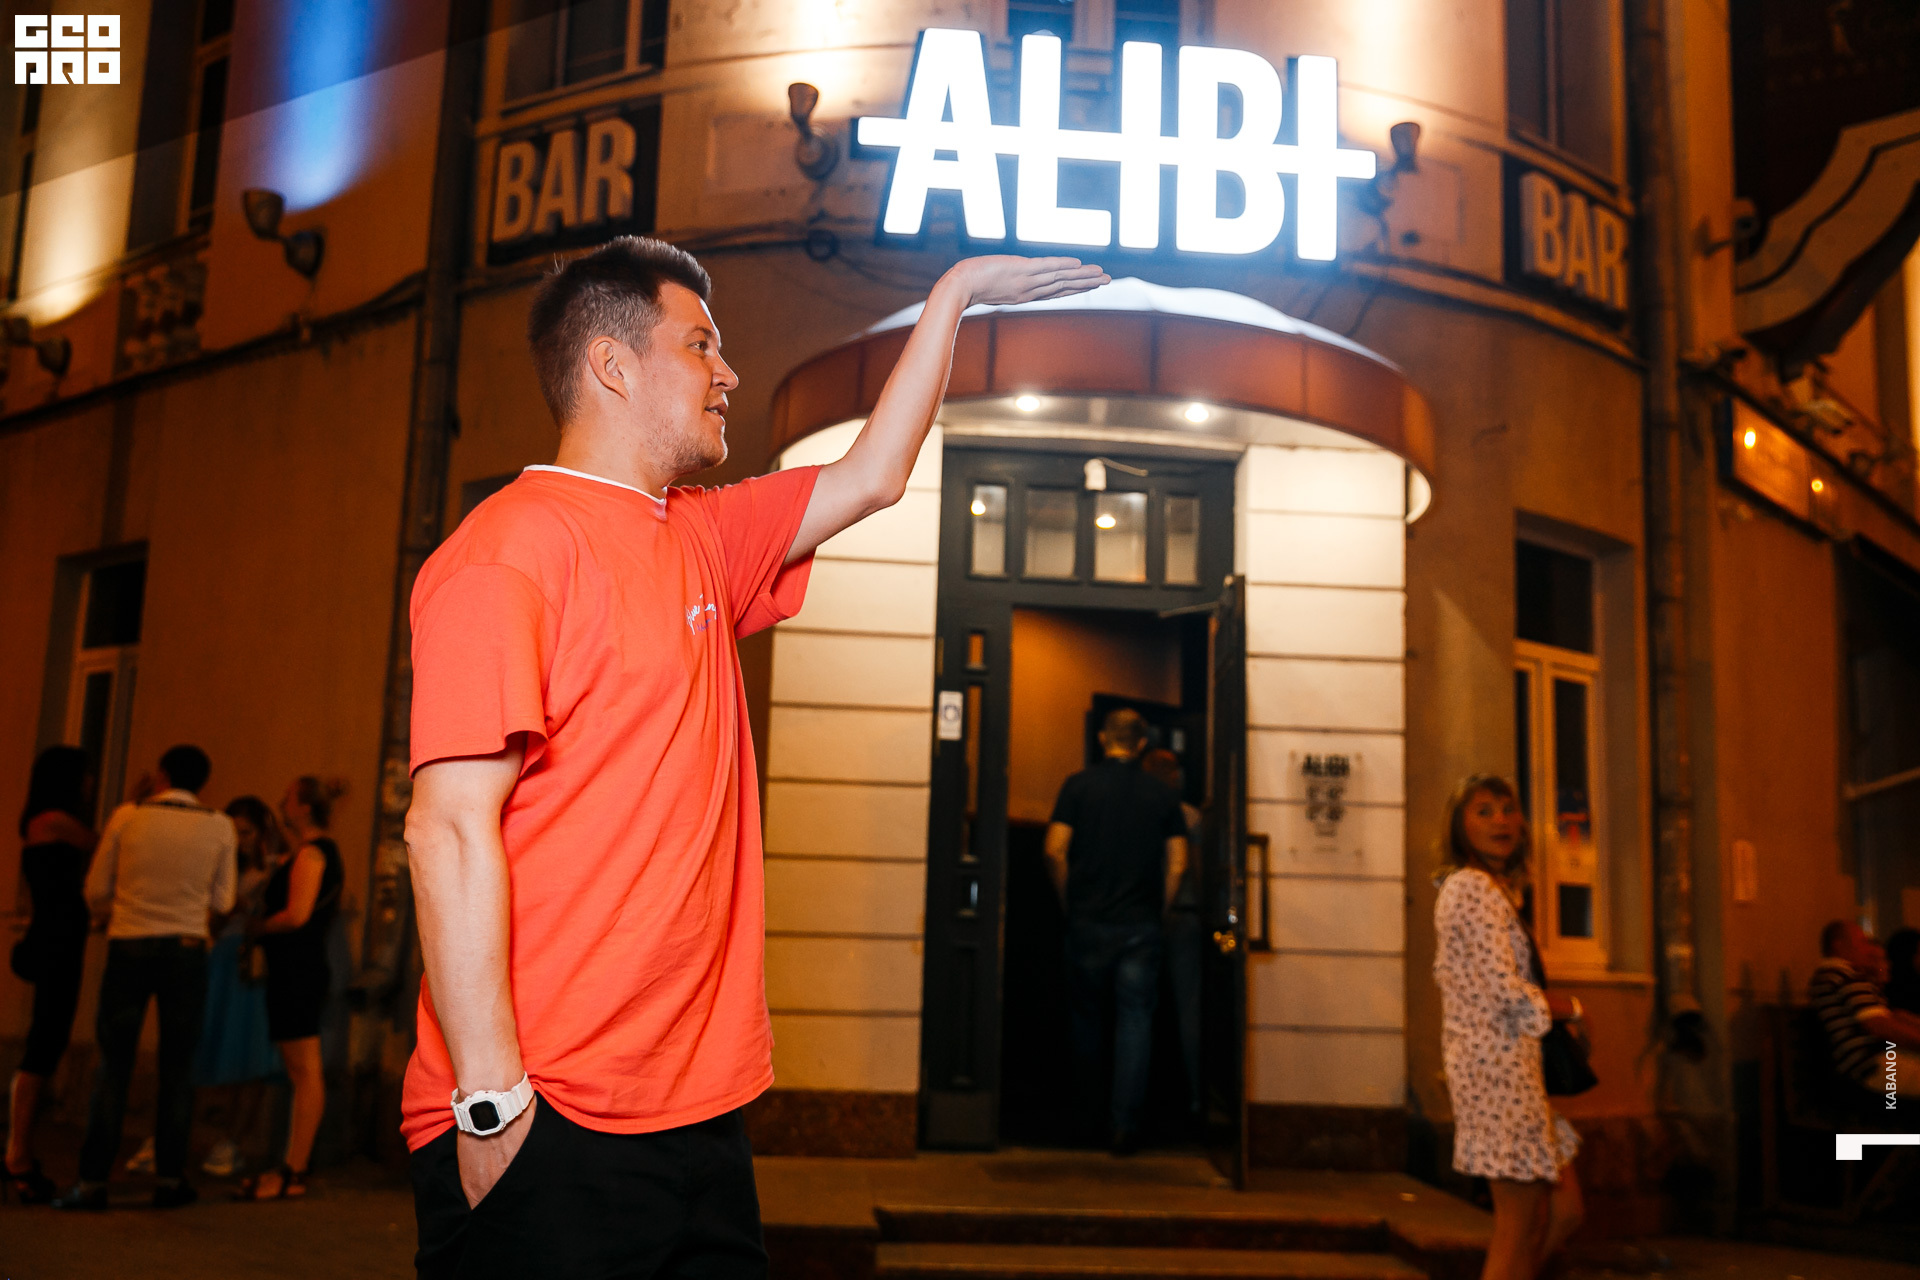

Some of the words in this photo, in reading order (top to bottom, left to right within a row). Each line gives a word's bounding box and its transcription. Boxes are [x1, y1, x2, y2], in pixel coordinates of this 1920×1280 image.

[492, 117, 636, 243] BAR
[880, 27, 1340, 262] ALIBI
[1520, 172, 1628, 311] BAR
